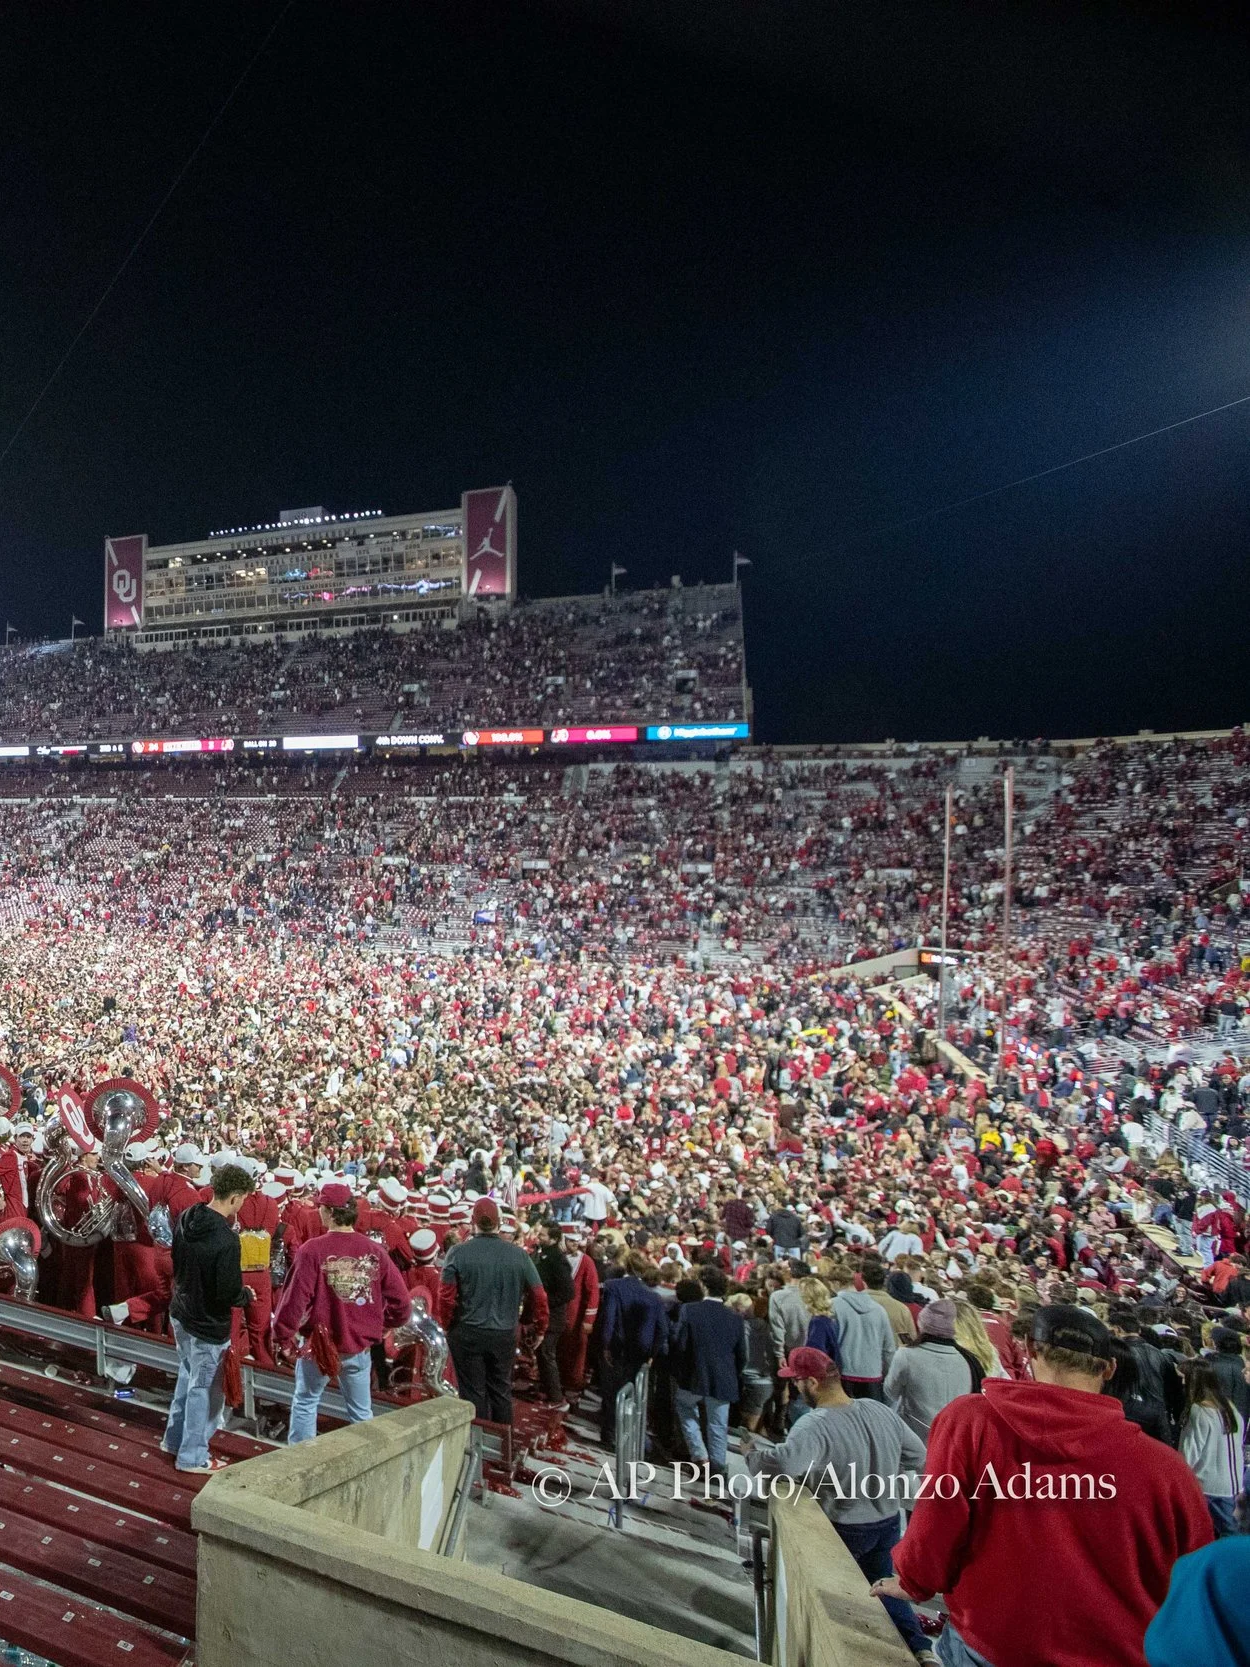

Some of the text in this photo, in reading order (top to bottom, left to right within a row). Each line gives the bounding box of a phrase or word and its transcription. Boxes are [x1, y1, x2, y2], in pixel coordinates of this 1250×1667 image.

[112, 569, 137, 602] OU
[390, 735, 418, 745] DOWN
[61, 1094, 95, 1146] OU
